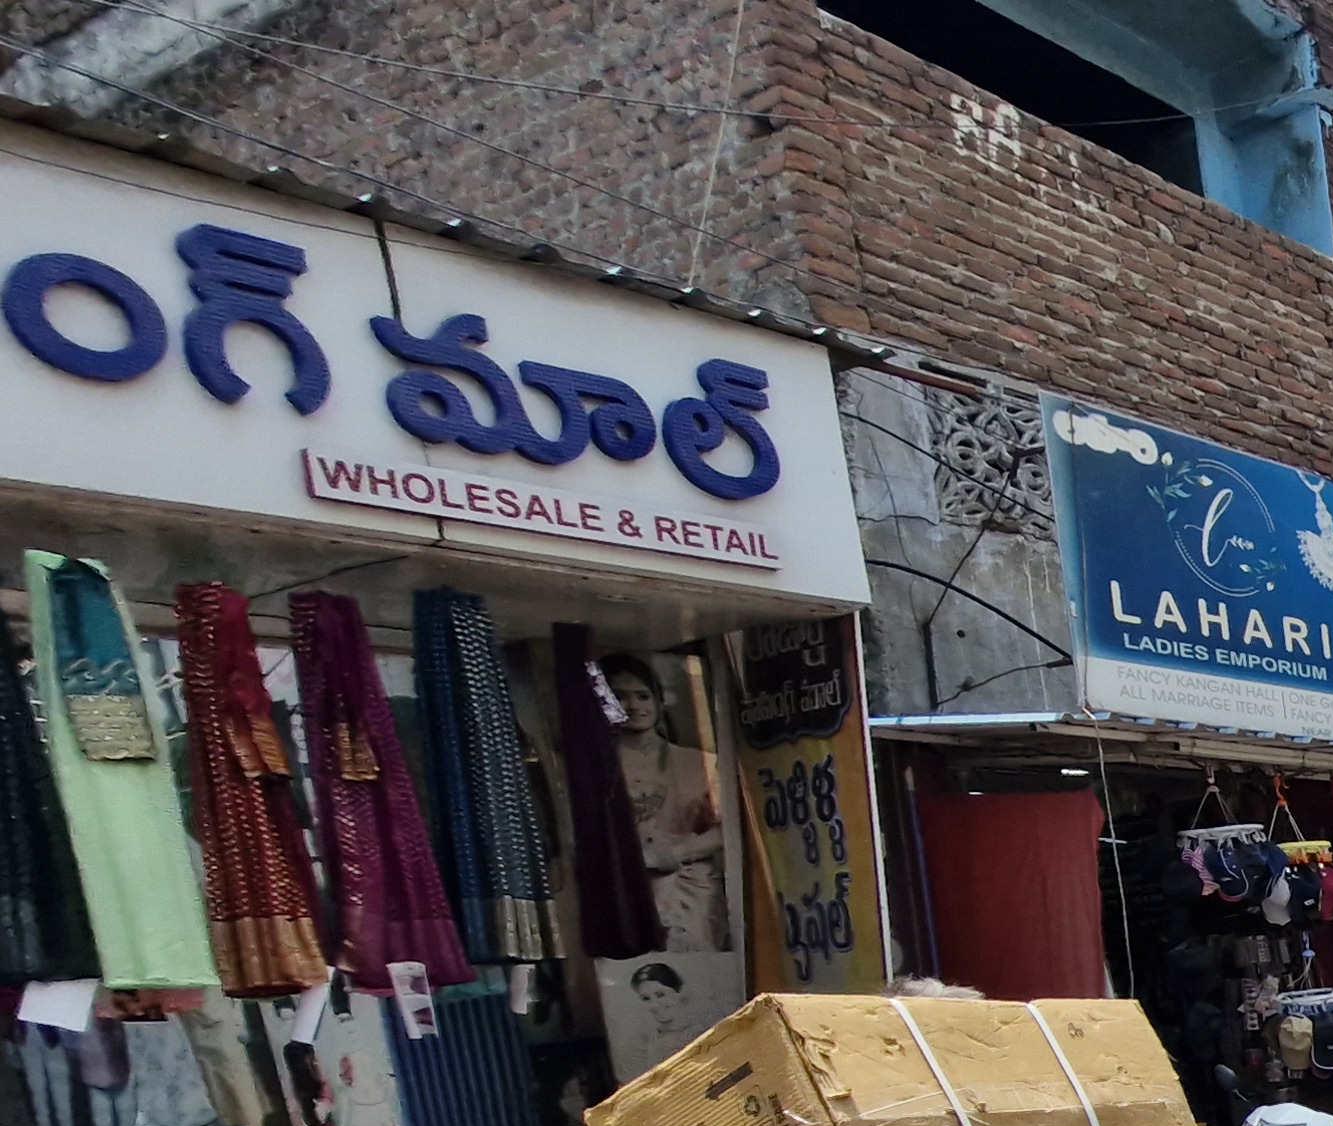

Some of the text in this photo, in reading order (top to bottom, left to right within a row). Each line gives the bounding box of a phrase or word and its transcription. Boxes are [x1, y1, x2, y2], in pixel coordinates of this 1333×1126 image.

[370, 314, 781, 500] మాల్
[316, 456, 779, 561] WHOLESALE & RETAIL
[1110, 579, 1332, 661] LAHARI
[1124, 632, 1328, 681] LADIES EMPORIUM
[1117, 666, 1278, 702] FANCY KANGAN HALL
[1120, 685, 1275, 718] ALL MARRIAGE ITEMS
[1289, 692, 1316, 708] ONE
[1291, 708, 1332, 724] FANCY
[1302, 725, 1332, 738] NEAR
